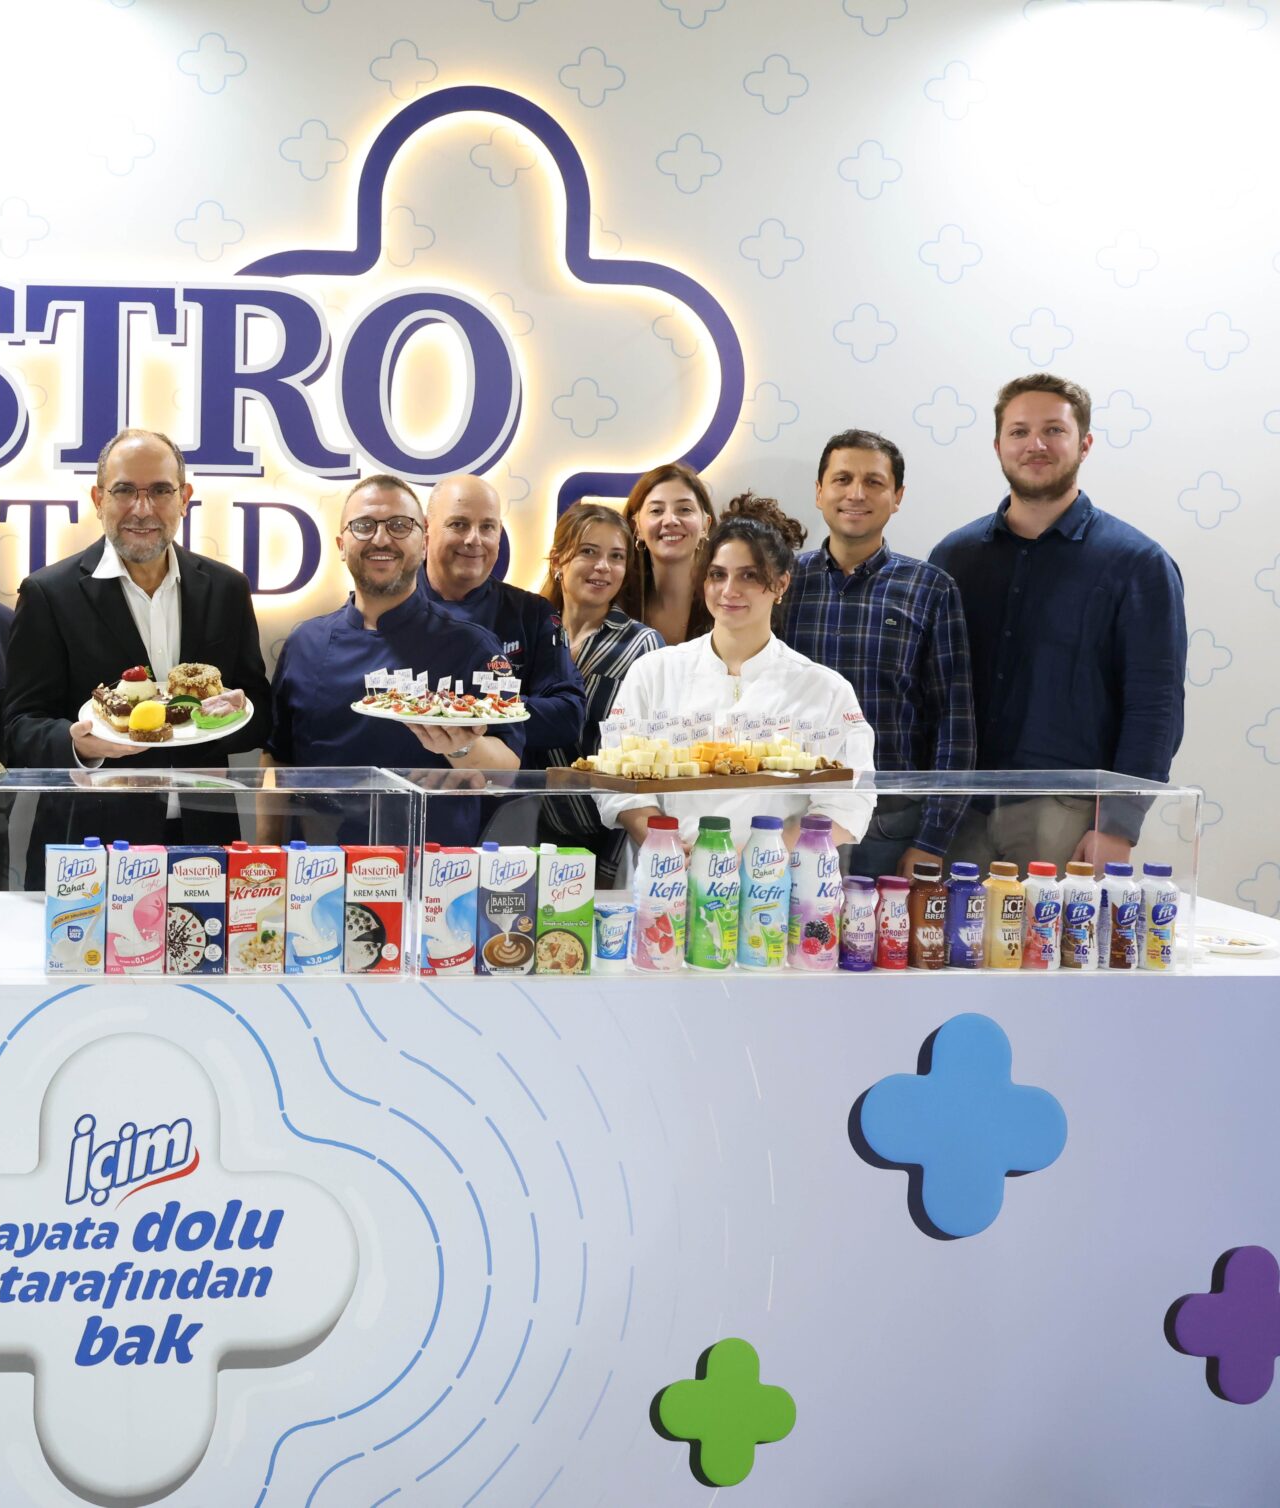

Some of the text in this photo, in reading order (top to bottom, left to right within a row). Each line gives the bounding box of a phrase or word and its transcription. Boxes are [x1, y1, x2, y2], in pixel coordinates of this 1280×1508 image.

[503, 640, 520, 654] im
[57, 882, 85, 897] Rahat
[184, 889, 209, 897] KREMA
[233, 886, 281, 900] Krema
[353, 888, 397, 898] KREM ŞANTİ
[649, 882, 686, 901] Kefir
[748, 884, 785, 902] Kefir
[112, 894, 133, 903] Doğal
[290, 894, 312, 902] Doğal
[425, 906, 443, 915] Yağlı
[1041, 904, 1056, 917] fit
[1072, 906, 1088, 918] fit
[1124, 905, 1138, 919] fit
[1159, 905, 1175, 918] fit
[132, 1200, 284, 1252] dolu
[75, 1314, 203, 1366] bak
